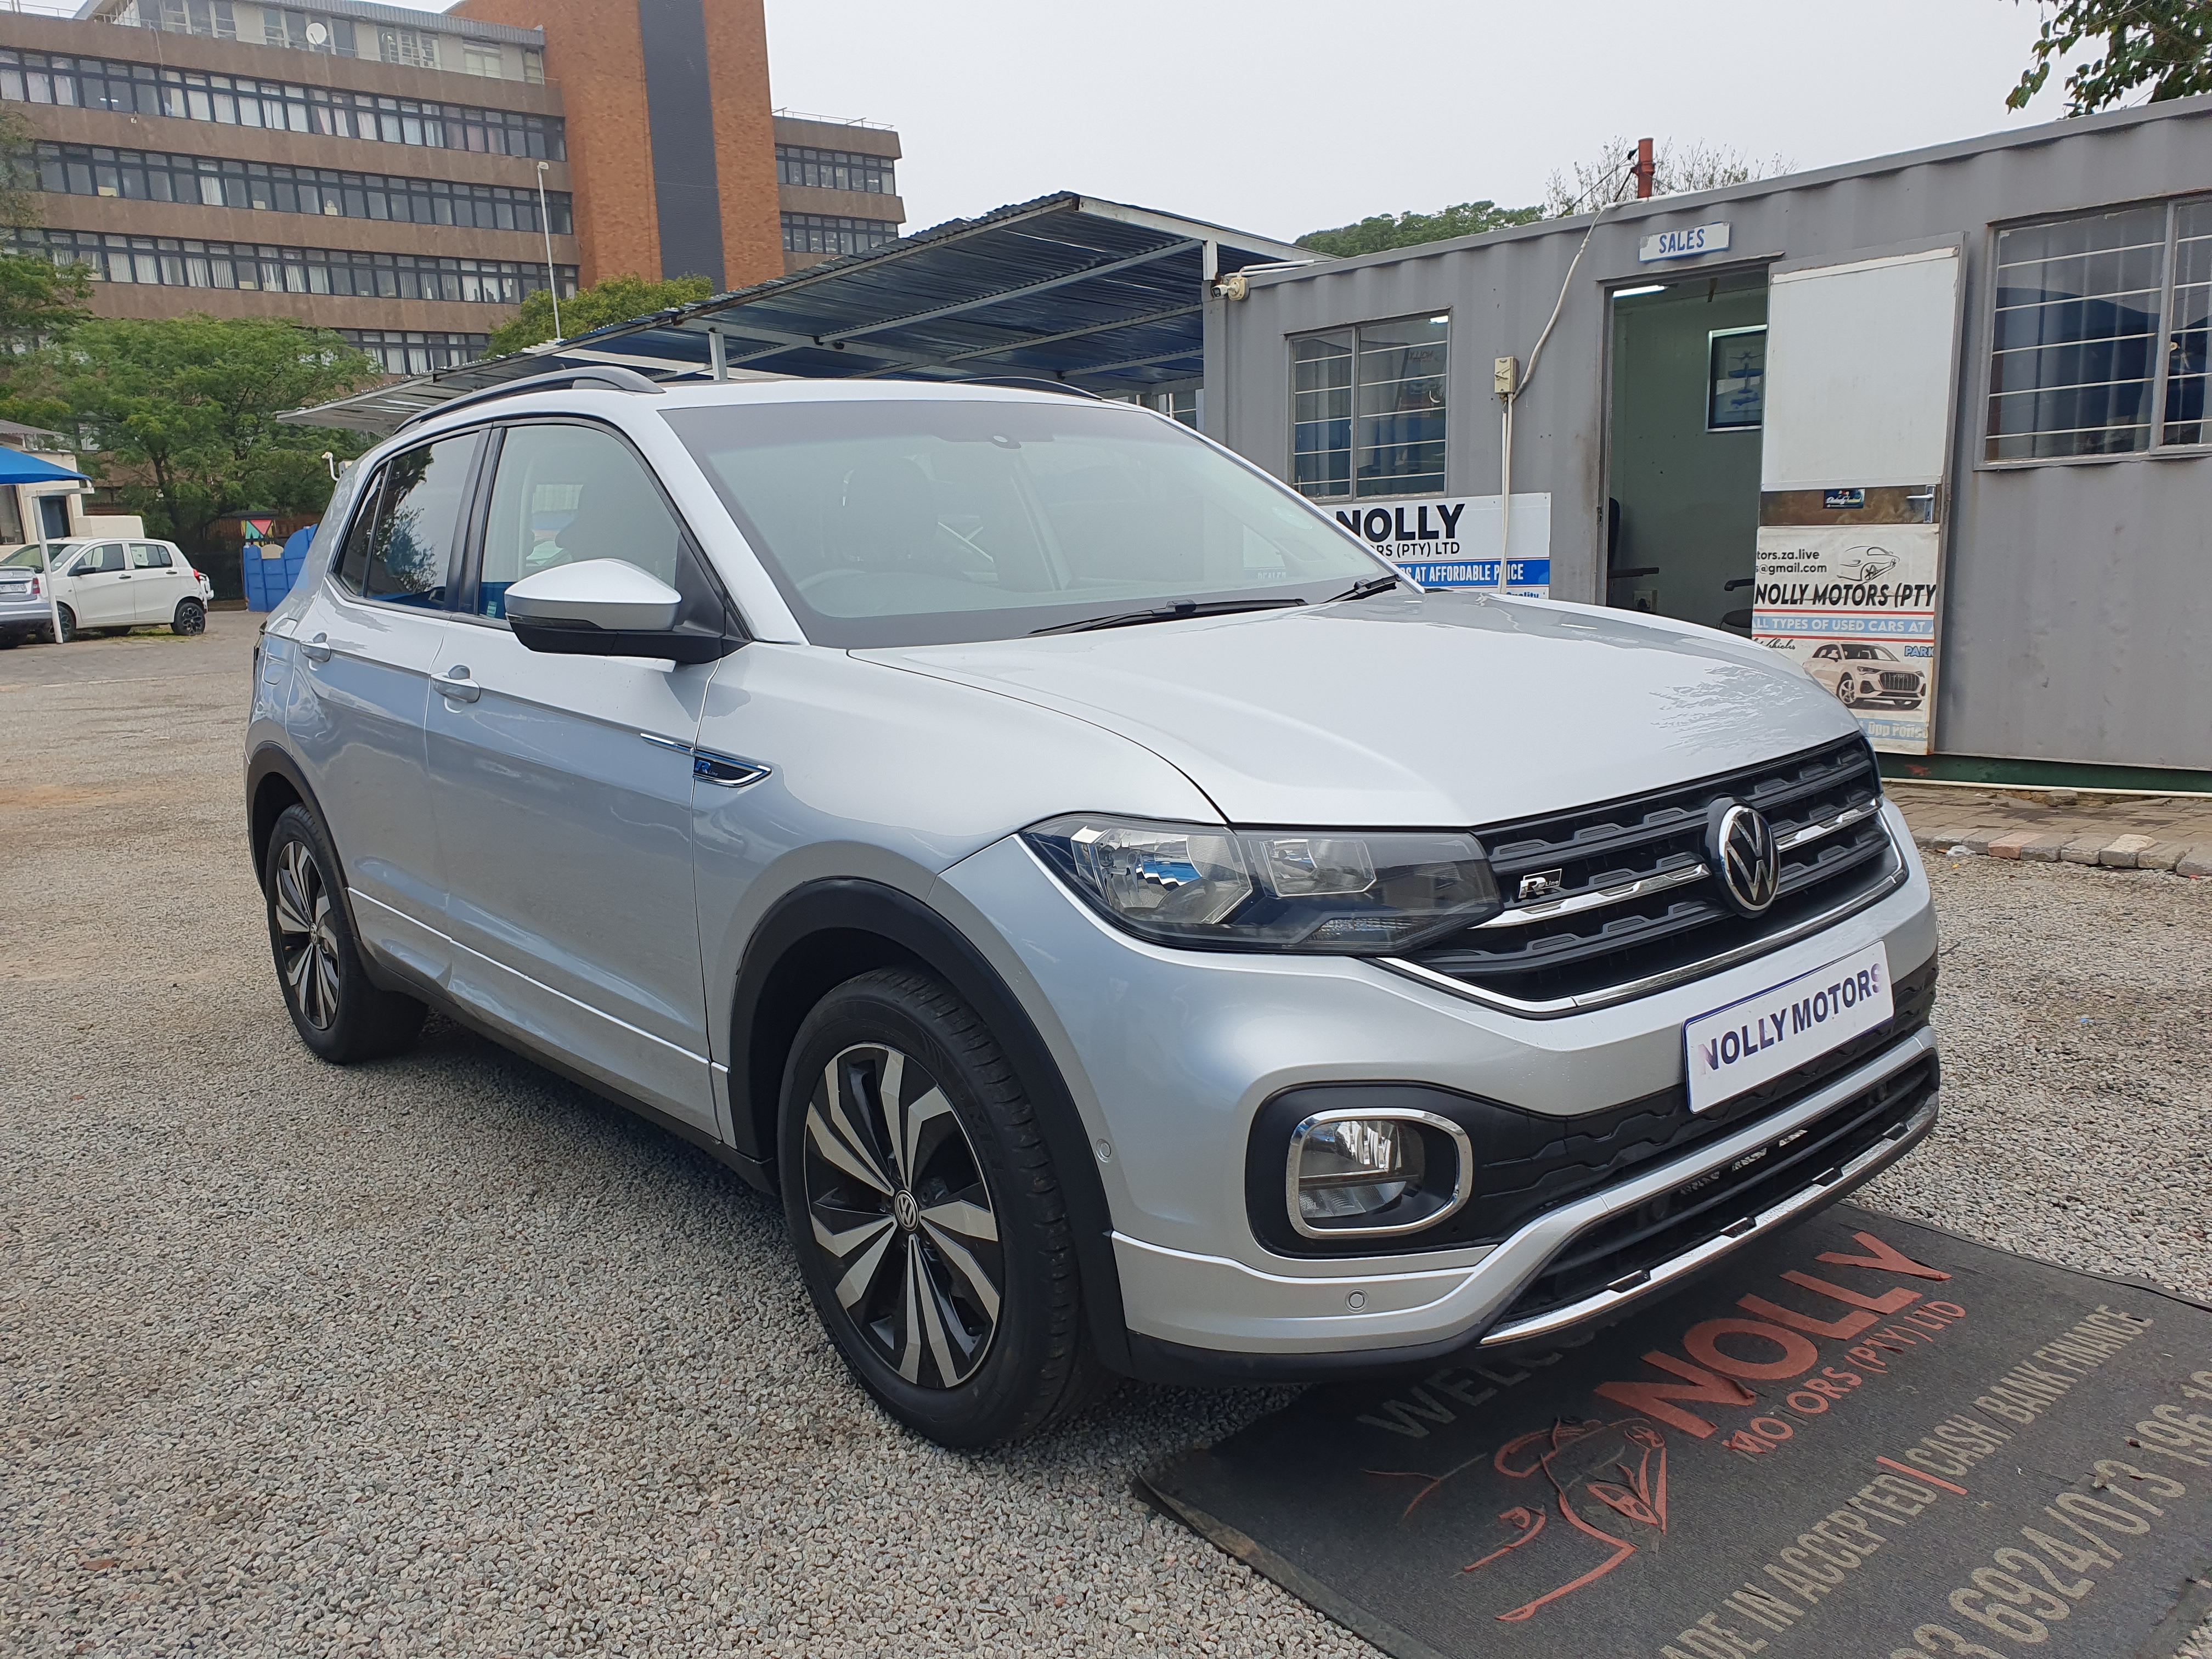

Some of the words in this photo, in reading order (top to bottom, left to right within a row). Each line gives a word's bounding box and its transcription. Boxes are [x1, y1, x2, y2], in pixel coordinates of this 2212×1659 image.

[1659, 228, 1705, 253] SALES
[1336, 504, 1466, 543] NOLLY
[1396, 541, 1431, 558] (PTY)
[1436, 541, 1460, 555] LTD
[1414, 566, 1426, 583] AT
[1429, 564, 1491, 582] AFFORDABLE
[1493, 563, 1523, 581] PICE
[1755, 583, 1809, 605] NOLLY
[1812, 584, 1890, 606] MOTORS
[1894, 583, 1936, 608] (PTY
[1772, 618, 1808, 630] TYPES
[1812, 619, 1829, 630] OF
[1832, 620, 1865, 631] USED
[1868, 620, 1904, 632] CARS
[1908, 621, 1926, 632] AT
[1867, 721, 1891, 737] Opp
[1698, 1007, 1787, 1075] NOLLY
[1792, 963, 1882, 1035] MOTORS
[1595, 1231, 1952, 1438] NOLLY
[1843, 1324, 1934, 1373] (PTY)
[1903, 1301, 1966, 1330] LTD
[2032, 1304, 2154, 1375] FINANCE
[1762, 1473, 1938, 1604] ACCEPTED
[1948, 1459, 2186, 1644] 6924/073
[1722, 1582, 1805, 1633] IN
